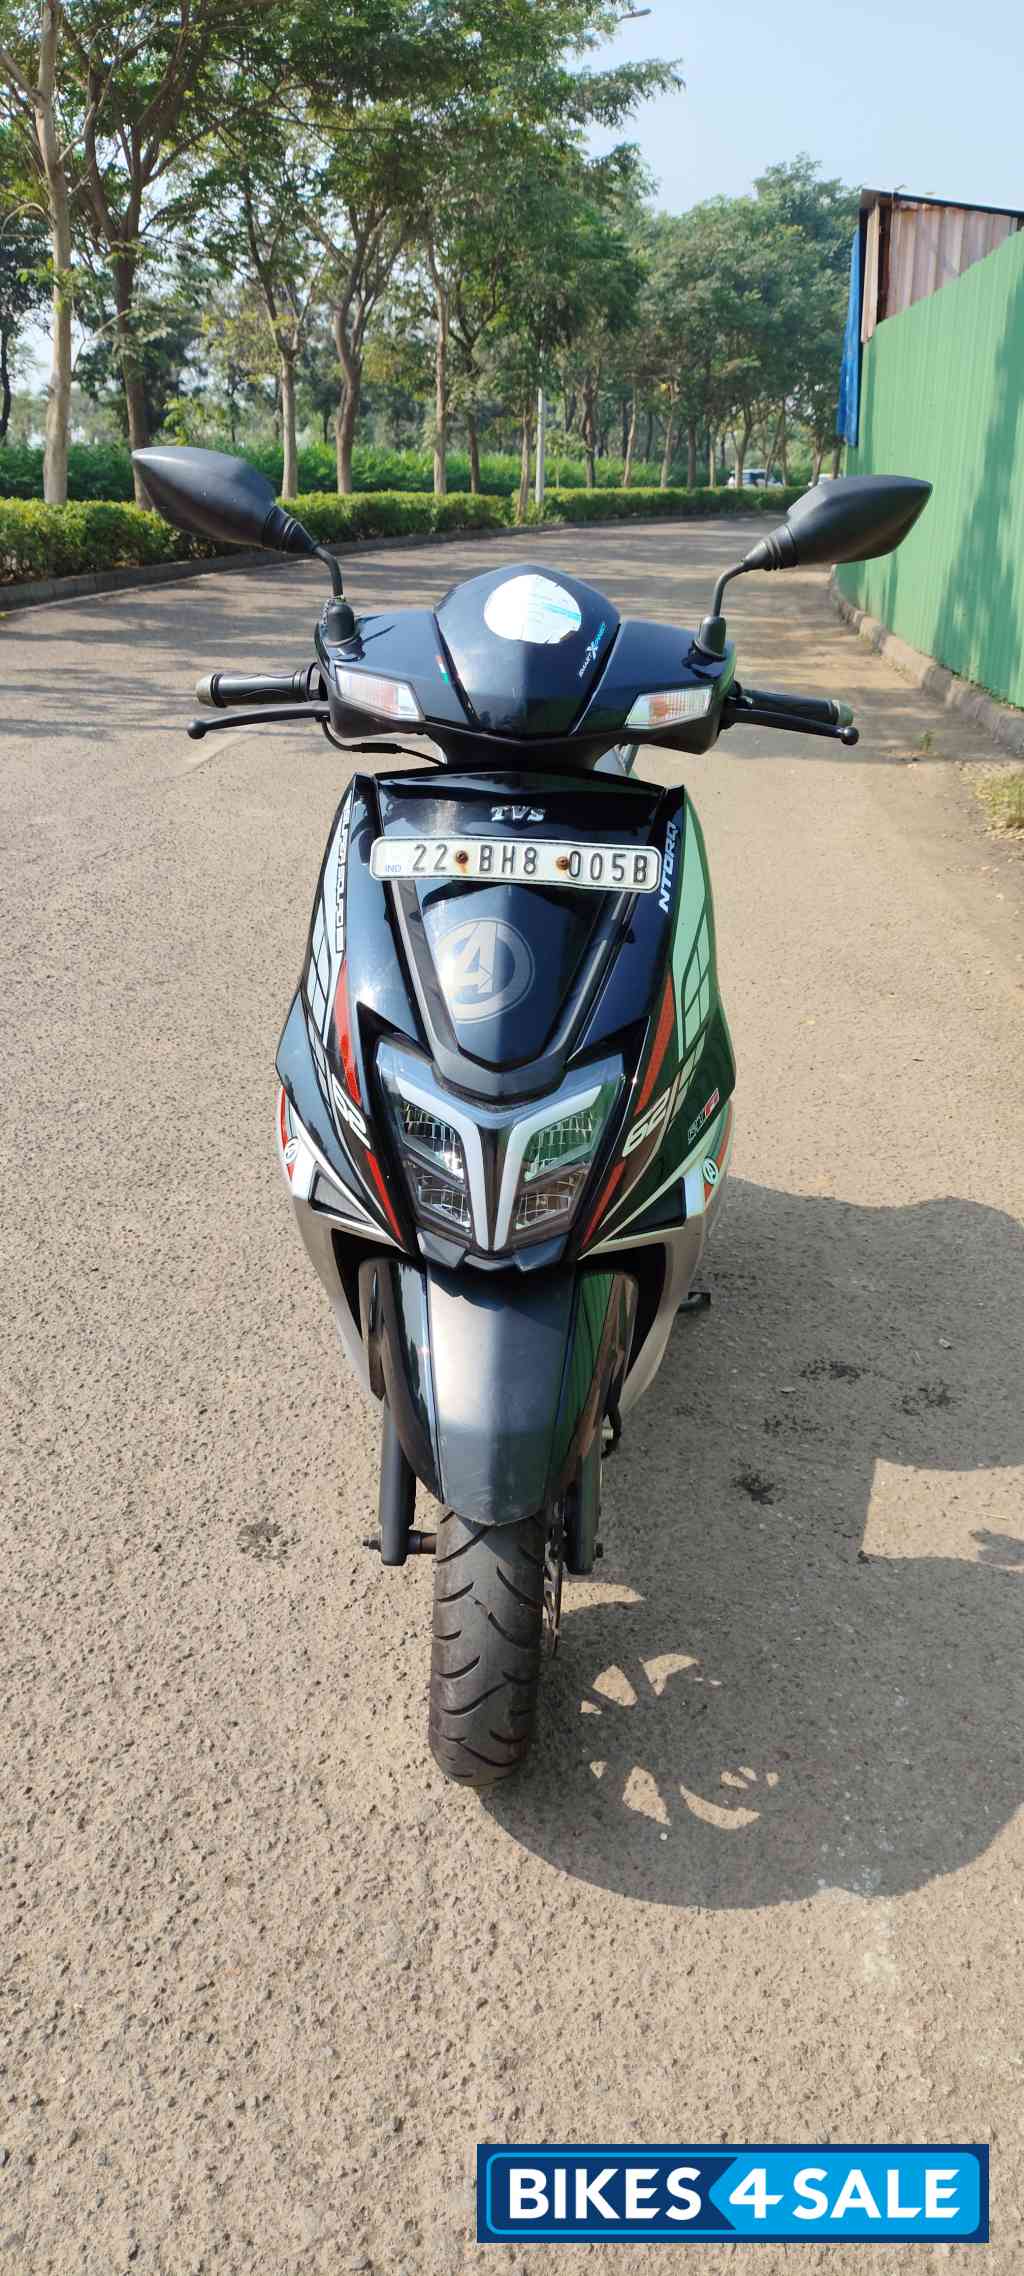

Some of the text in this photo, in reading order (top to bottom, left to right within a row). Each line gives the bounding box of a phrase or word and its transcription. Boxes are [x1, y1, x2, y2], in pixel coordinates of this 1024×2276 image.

[490, 805, 546, 822] TVS
[384, 864, 403, 873] IND
[412, 843, 449, 873] 22
[479, 844, 538, 876] BH8
[658, 820, 681, 913] NTORQ
